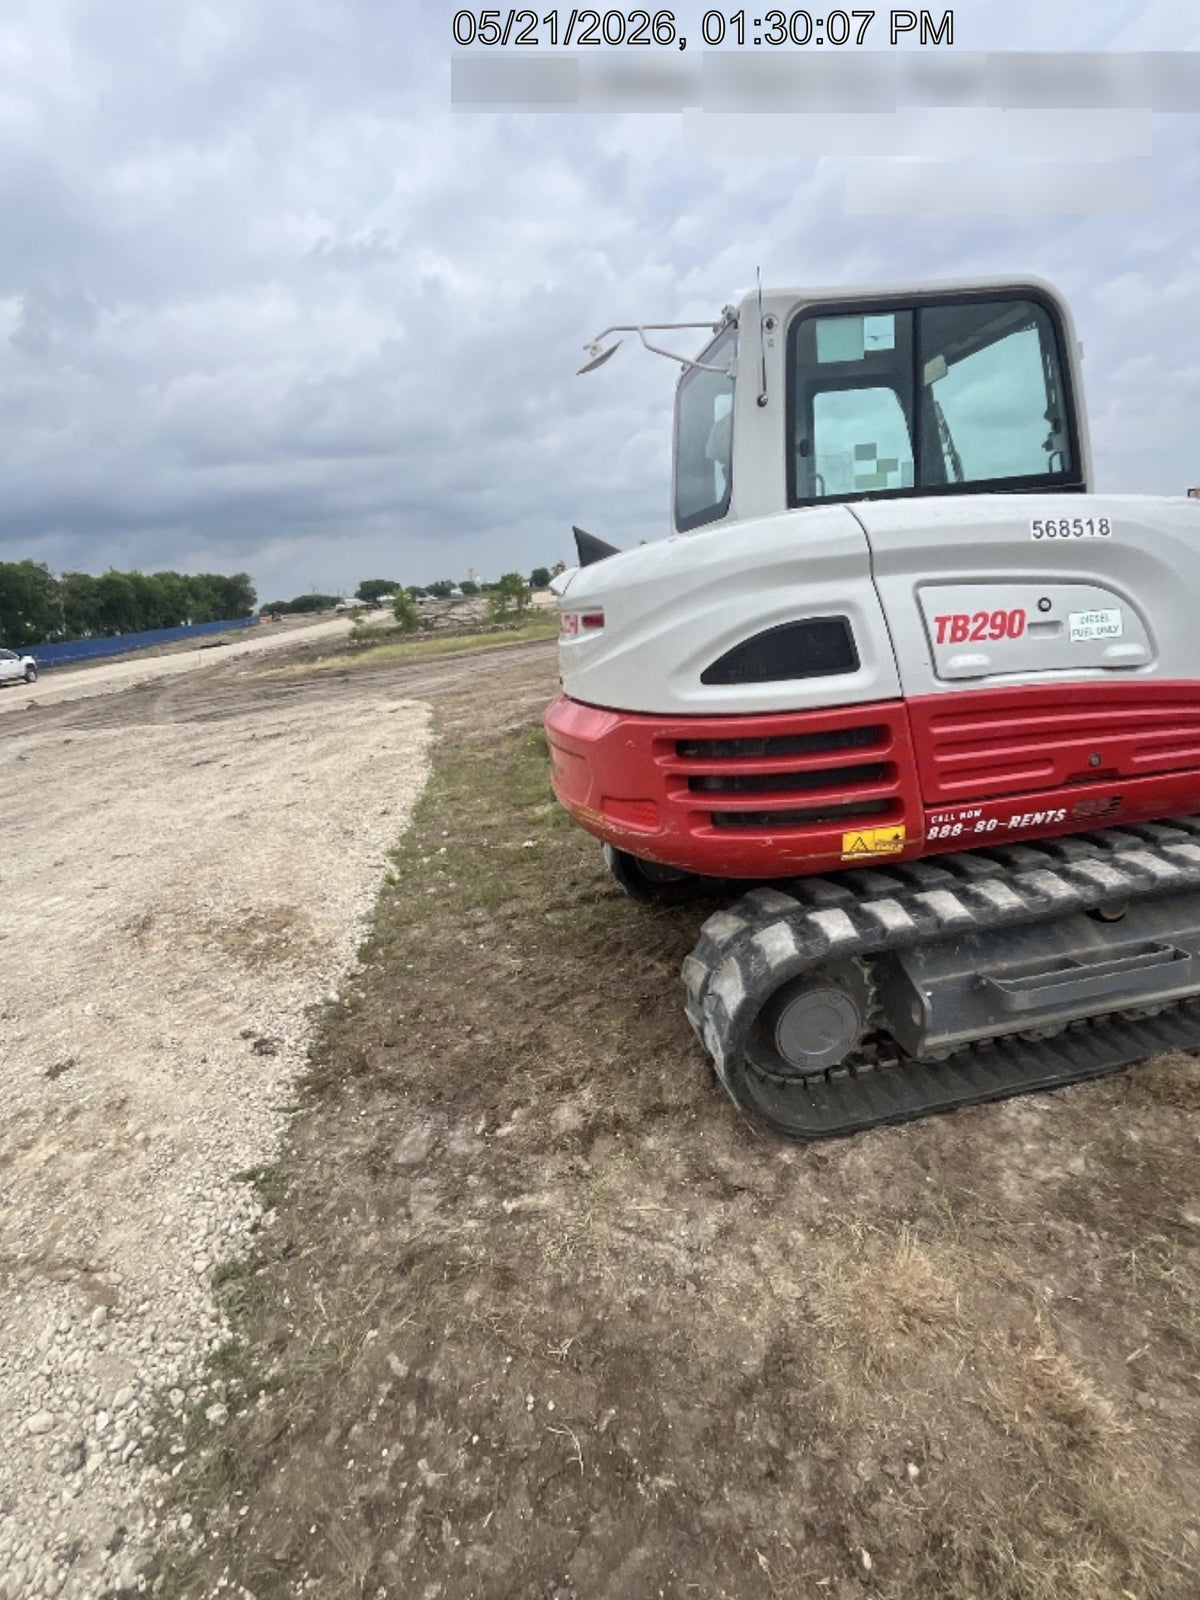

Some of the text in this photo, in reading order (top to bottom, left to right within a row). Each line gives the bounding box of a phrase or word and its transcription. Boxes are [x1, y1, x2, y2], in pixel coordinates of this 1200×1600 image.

[1032, 518, 1110, 539] 568518
[934, 608, 1027, 645] TB290
[1080, 613, 1109, 624] DIESEL
[1072, 624, 1119, 637] FUEL ONLY
[931, 808, 983, 824] CALL NOW
